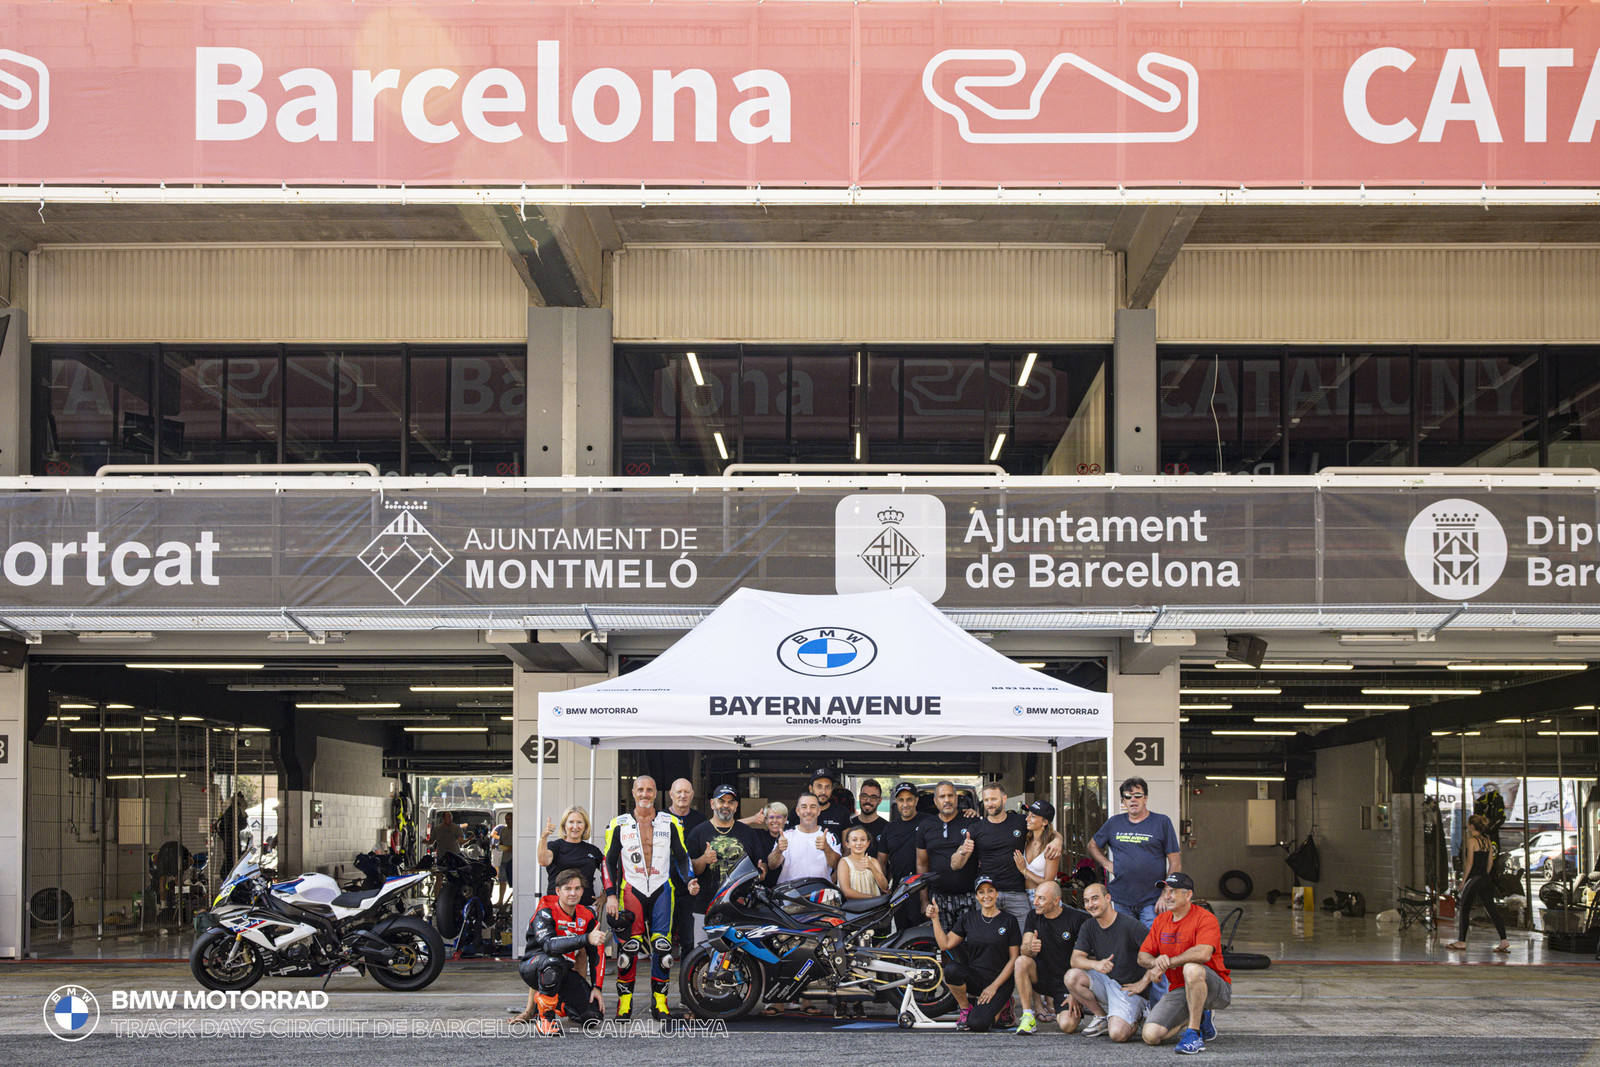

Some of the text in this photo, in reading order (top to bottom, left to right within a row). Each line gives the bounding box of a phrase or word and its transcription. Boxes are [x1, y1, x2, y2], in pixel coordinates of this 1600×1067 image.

[195, 40, 792, 144] Barcelona
[463, 527, 698, 551] AJUNTAMENT DE
[964, 509, 1208, 552] Ajuntament
[1526, 515, 1600, 552] Dip
[3, 530, 220, 587] ortcat
[463, 552, 698, 589] MONTMELÓ
[965, 553, 1241, 588] de Barcelona
[1527, 556, 1600, 587] Bar
[792, 630, 864, 645] BMW
[565, 707, 639, 715] BMW MOTORRAD
[709, 696, 941, 716] BAYERN AVENUE
[1026, 707, 1100, 715] BMW MOTORRAD
[785, 716, 862, 726] Cannes-Mougins
[529, 739, 557, 759] 32
[1134, 741, 1159, 762] 31
